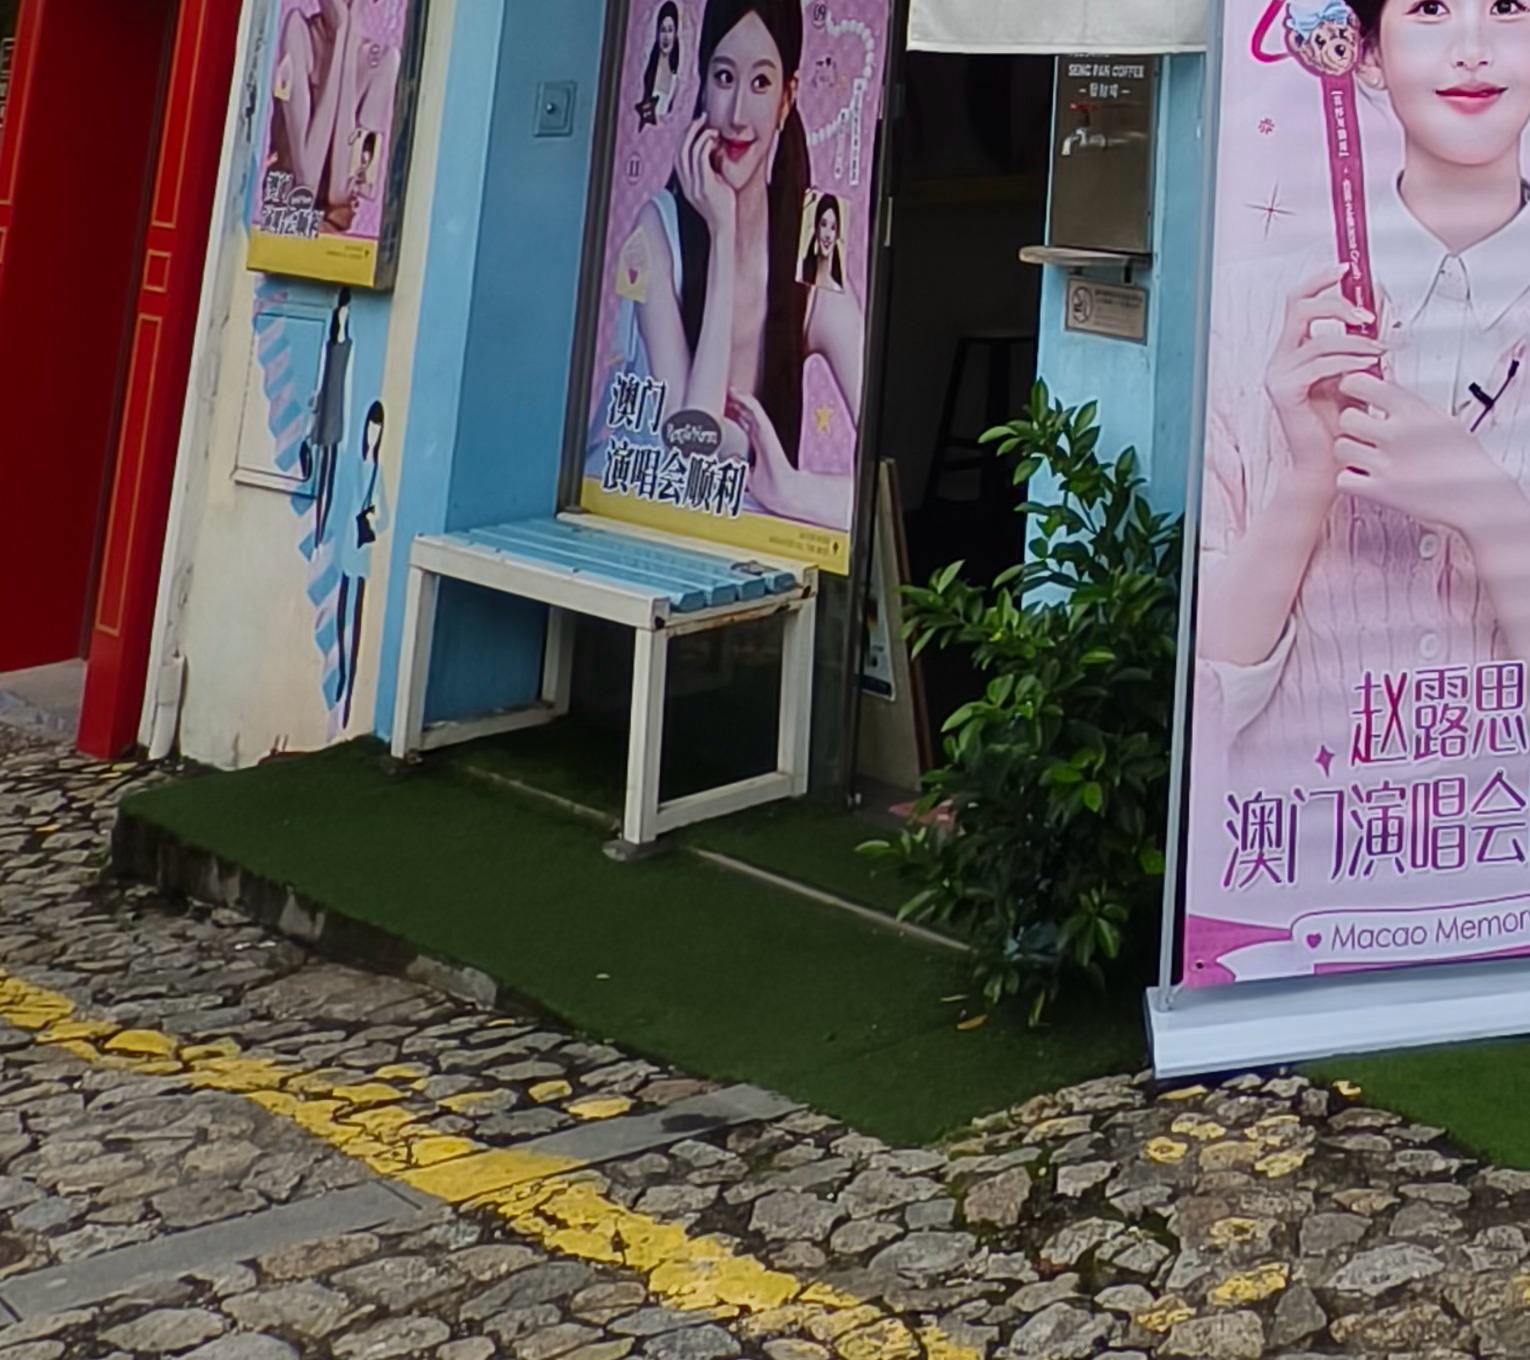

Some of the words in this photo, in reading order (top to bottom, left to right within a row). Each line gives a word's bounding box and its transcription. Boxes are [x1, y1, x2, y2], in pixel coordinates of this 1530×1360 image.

[607, 373, 668, 433] 澳门
[602, 439, 747, 518] 演唱会顺利
[1350, 662, 1528, 767] 赵露思
[1331, 921, 1428, 952] Macao
